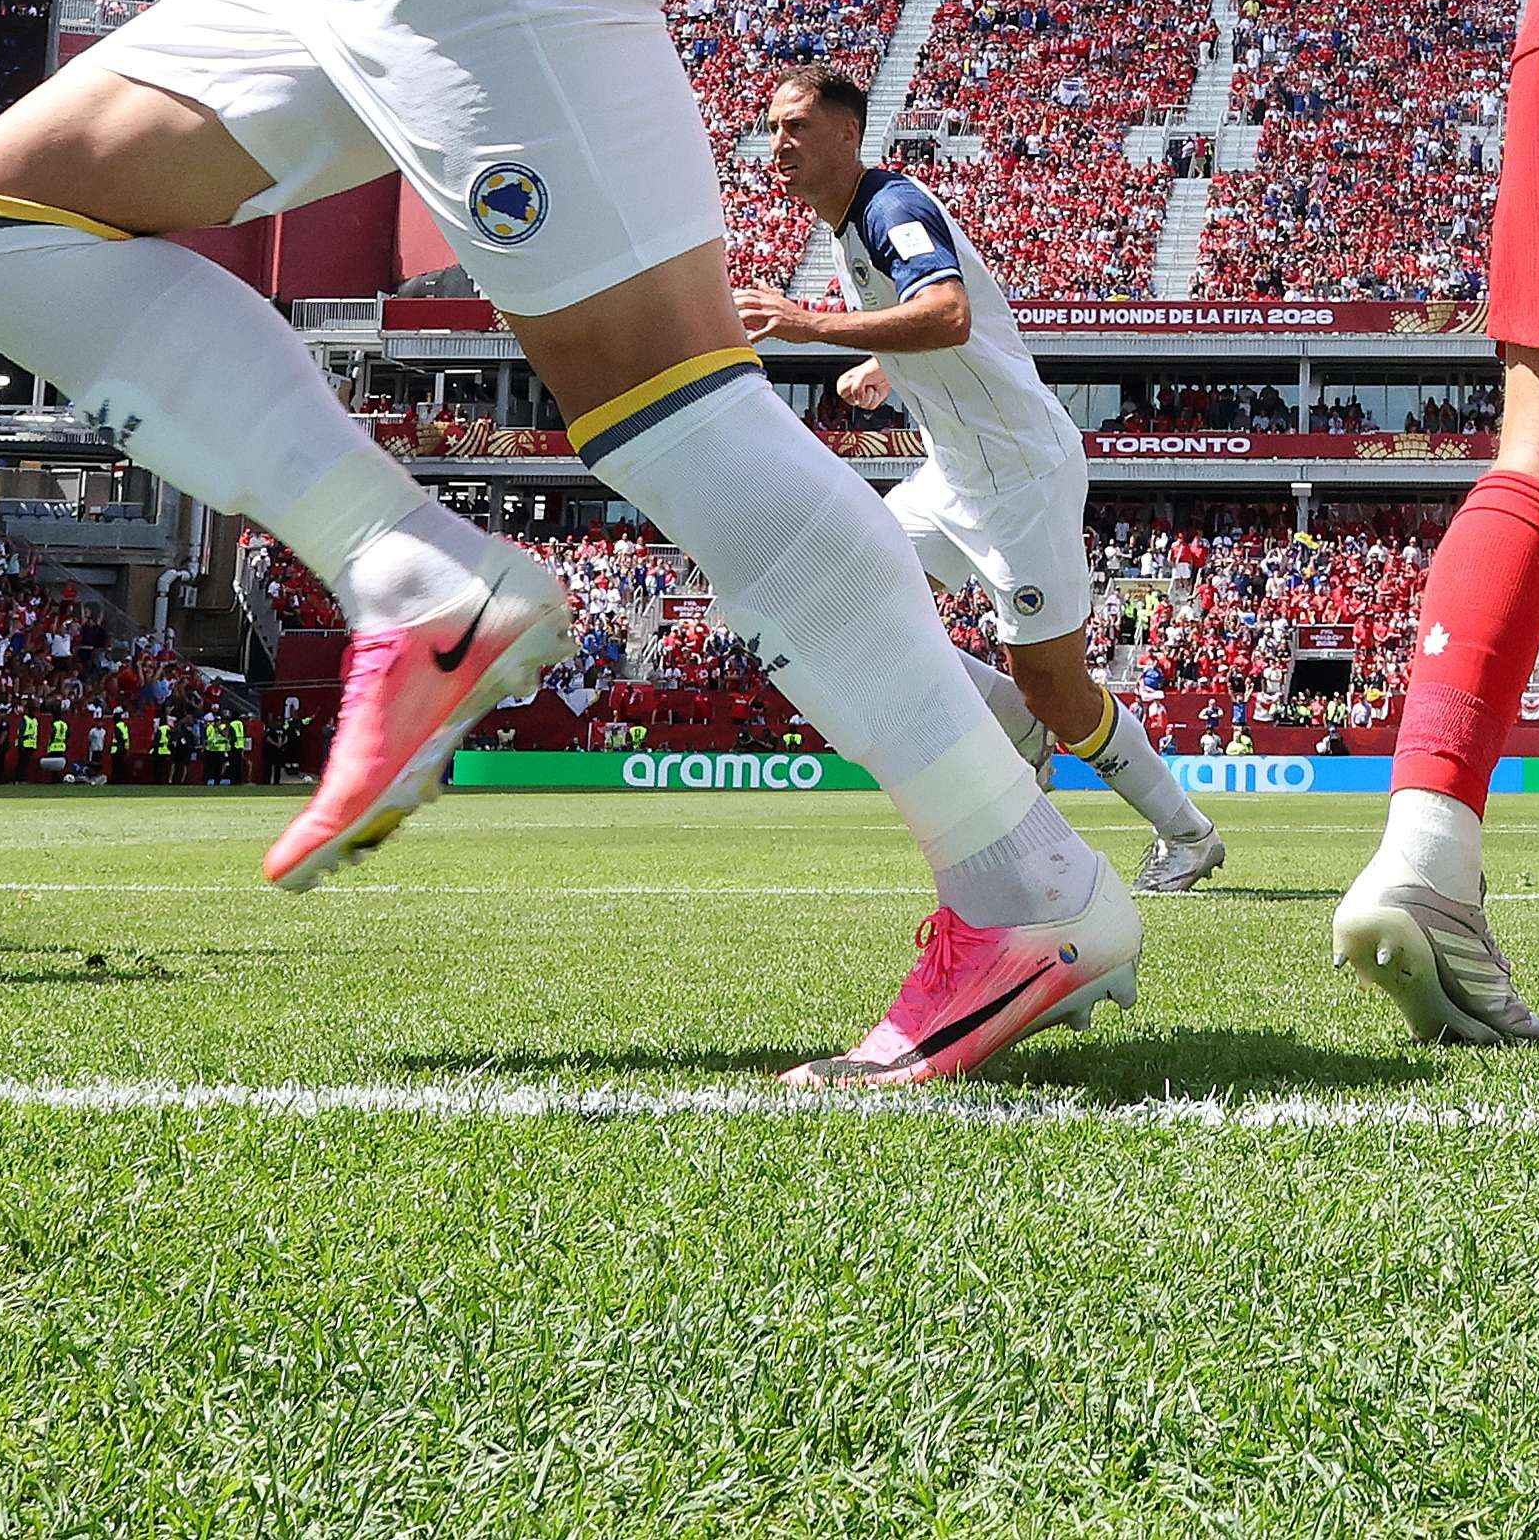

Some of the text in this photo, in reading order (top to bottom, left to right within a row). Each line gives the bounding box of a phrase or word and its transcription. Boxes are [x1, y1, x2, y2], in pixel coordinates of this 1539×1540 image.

[1071, 308, 1096, 325] DU
[1100, 308, 1166, 324] MONDE
[1169, 308, 1193, 324] DE
[1196, 308, 1220, 324] LA
[1223, 308, 1264, 324] FIFA
[1267, 308, 1334, 324] 2026
[1095, 436, 1251, 455] TORONTO
[622, 753, 823, 790] aramco
[1171, 756, 1314, 792] ramco
